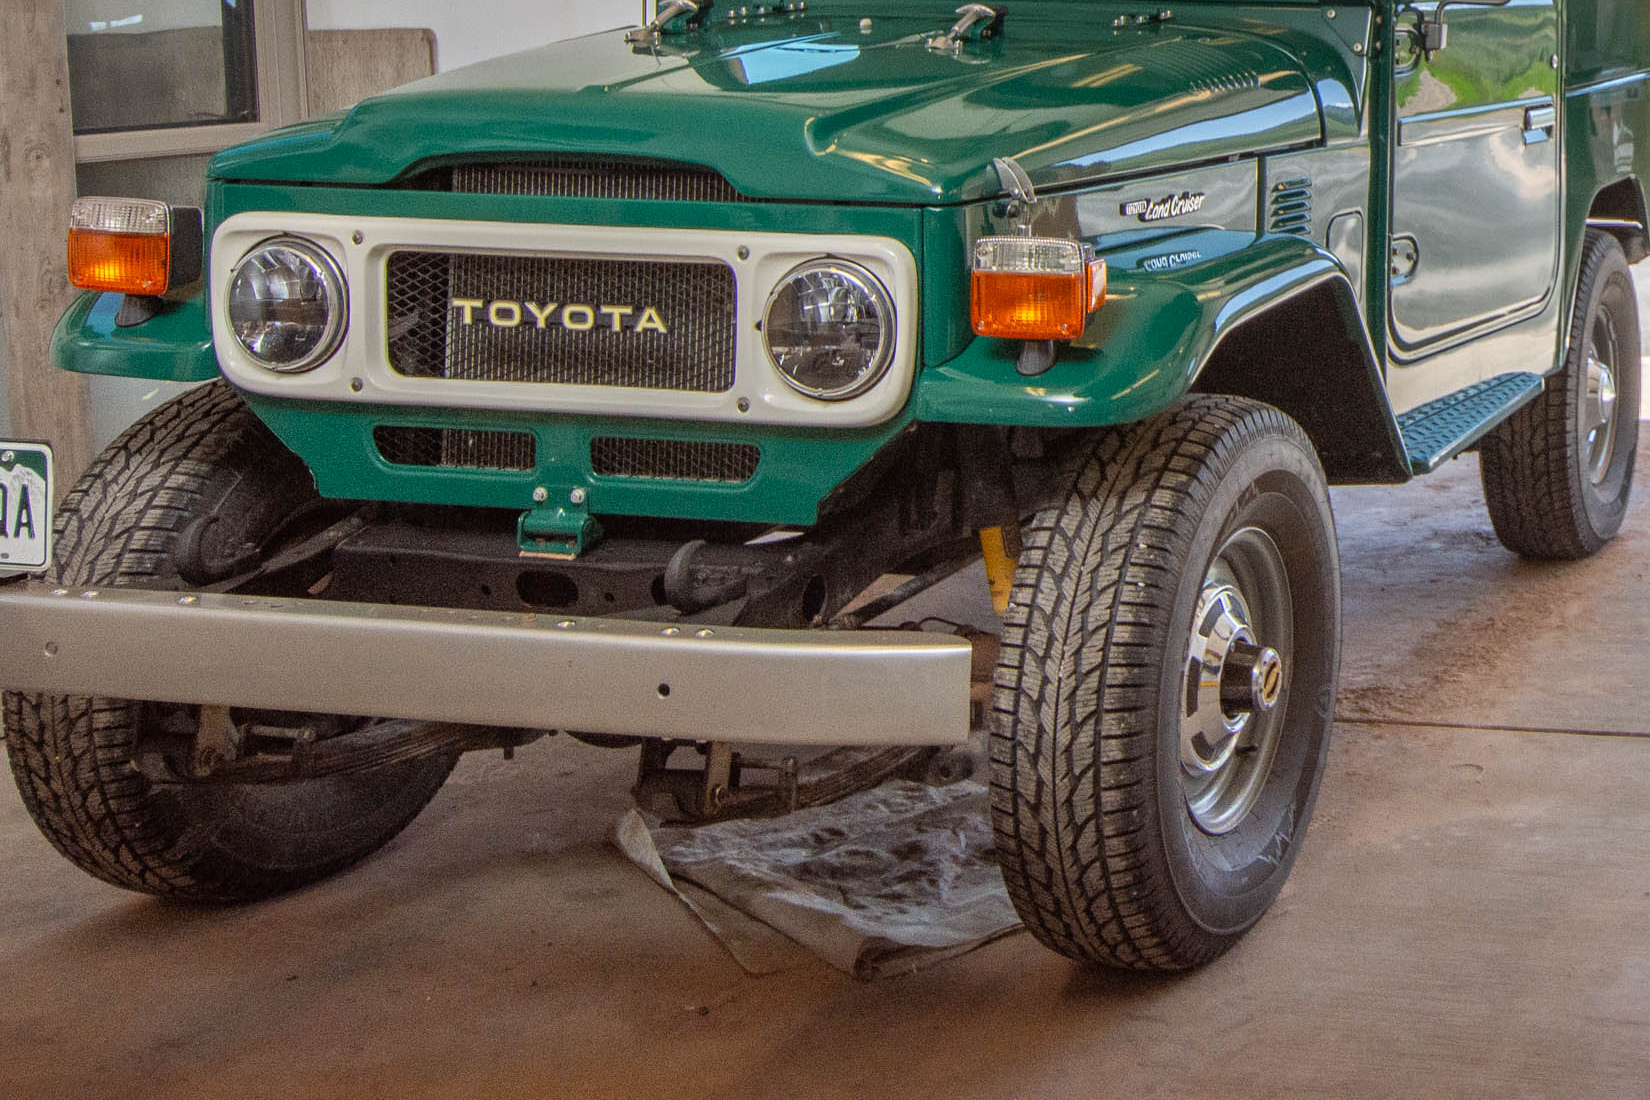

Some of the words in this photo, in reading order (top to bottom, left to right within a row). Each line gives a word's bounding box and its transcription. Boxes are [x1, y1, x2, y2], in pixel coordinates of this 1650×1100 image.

[1145, 200, 1171, 221] Land
[1171, 195, 1206, 217] Cruiser
[452, 298, 668, 334] TOYOTA
